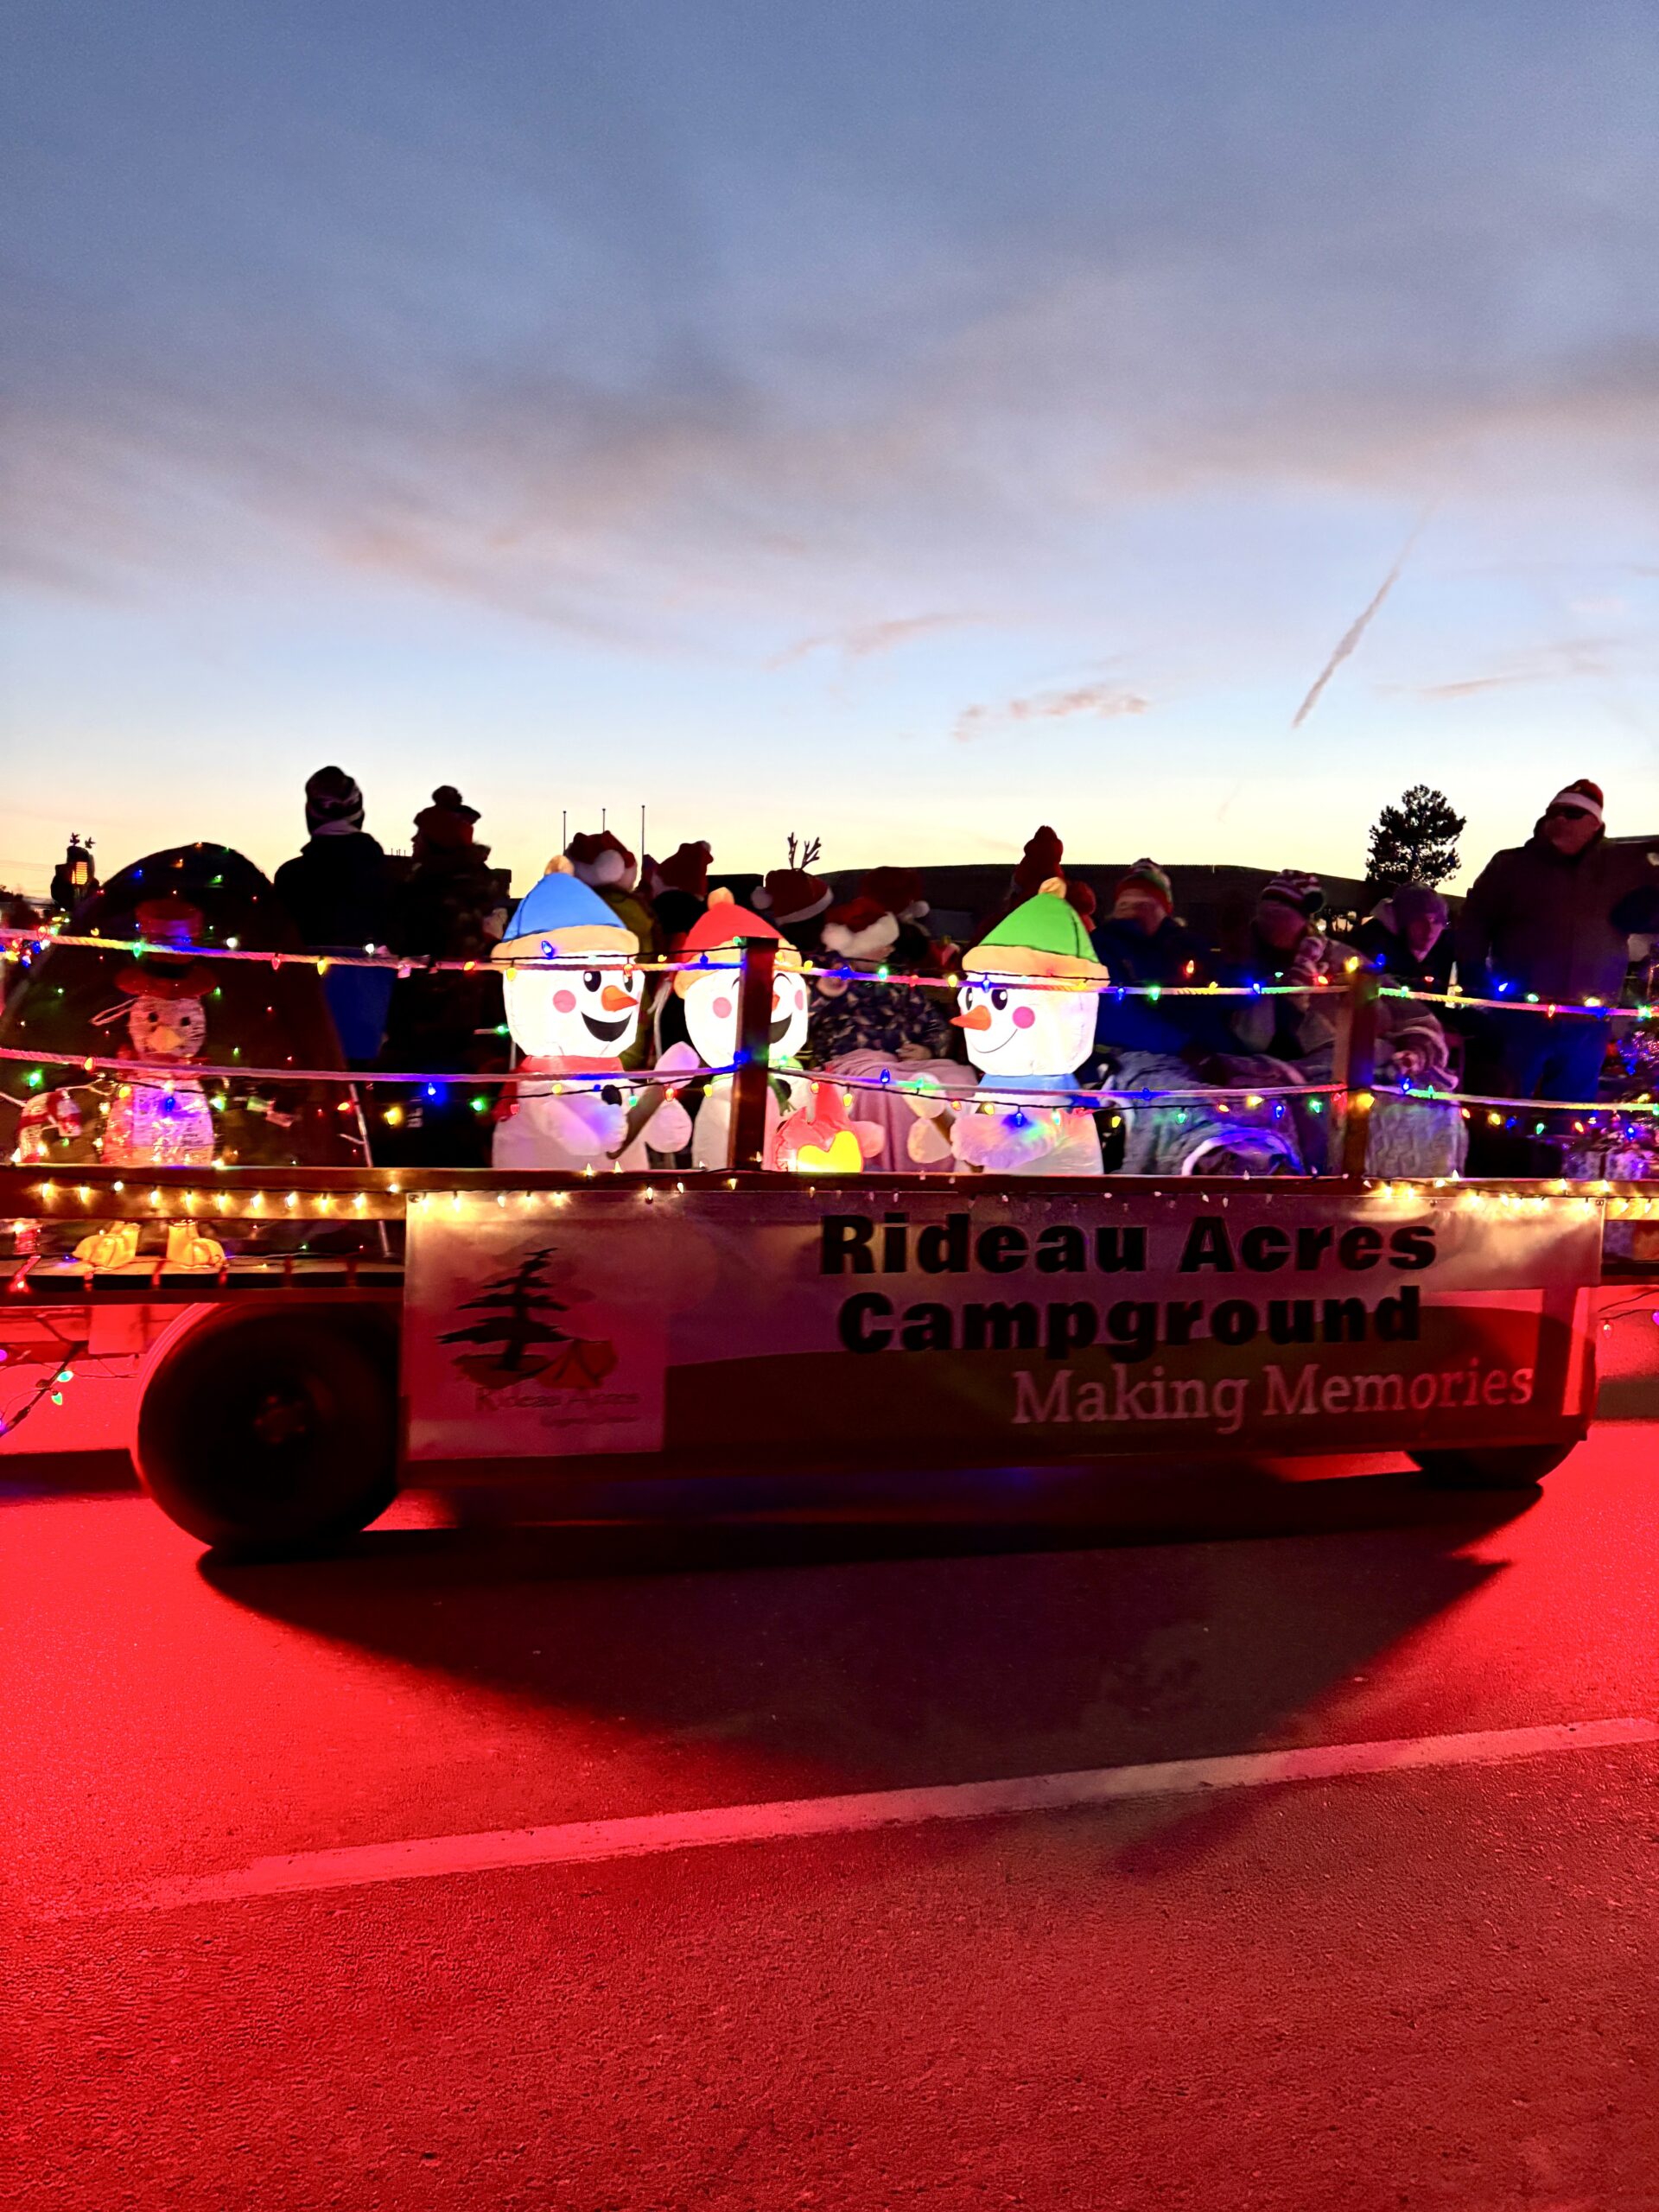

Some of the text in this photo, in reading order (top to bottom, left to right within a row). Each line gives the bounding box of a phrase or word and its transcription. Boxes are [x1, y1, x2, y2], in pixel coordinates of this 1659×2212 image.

[821, 1212, 1437, 1274] Rideau Acres
[839, 1285, 1421, 1363] Campground
[1012, 1357, 1535, 1434] Making Memories
